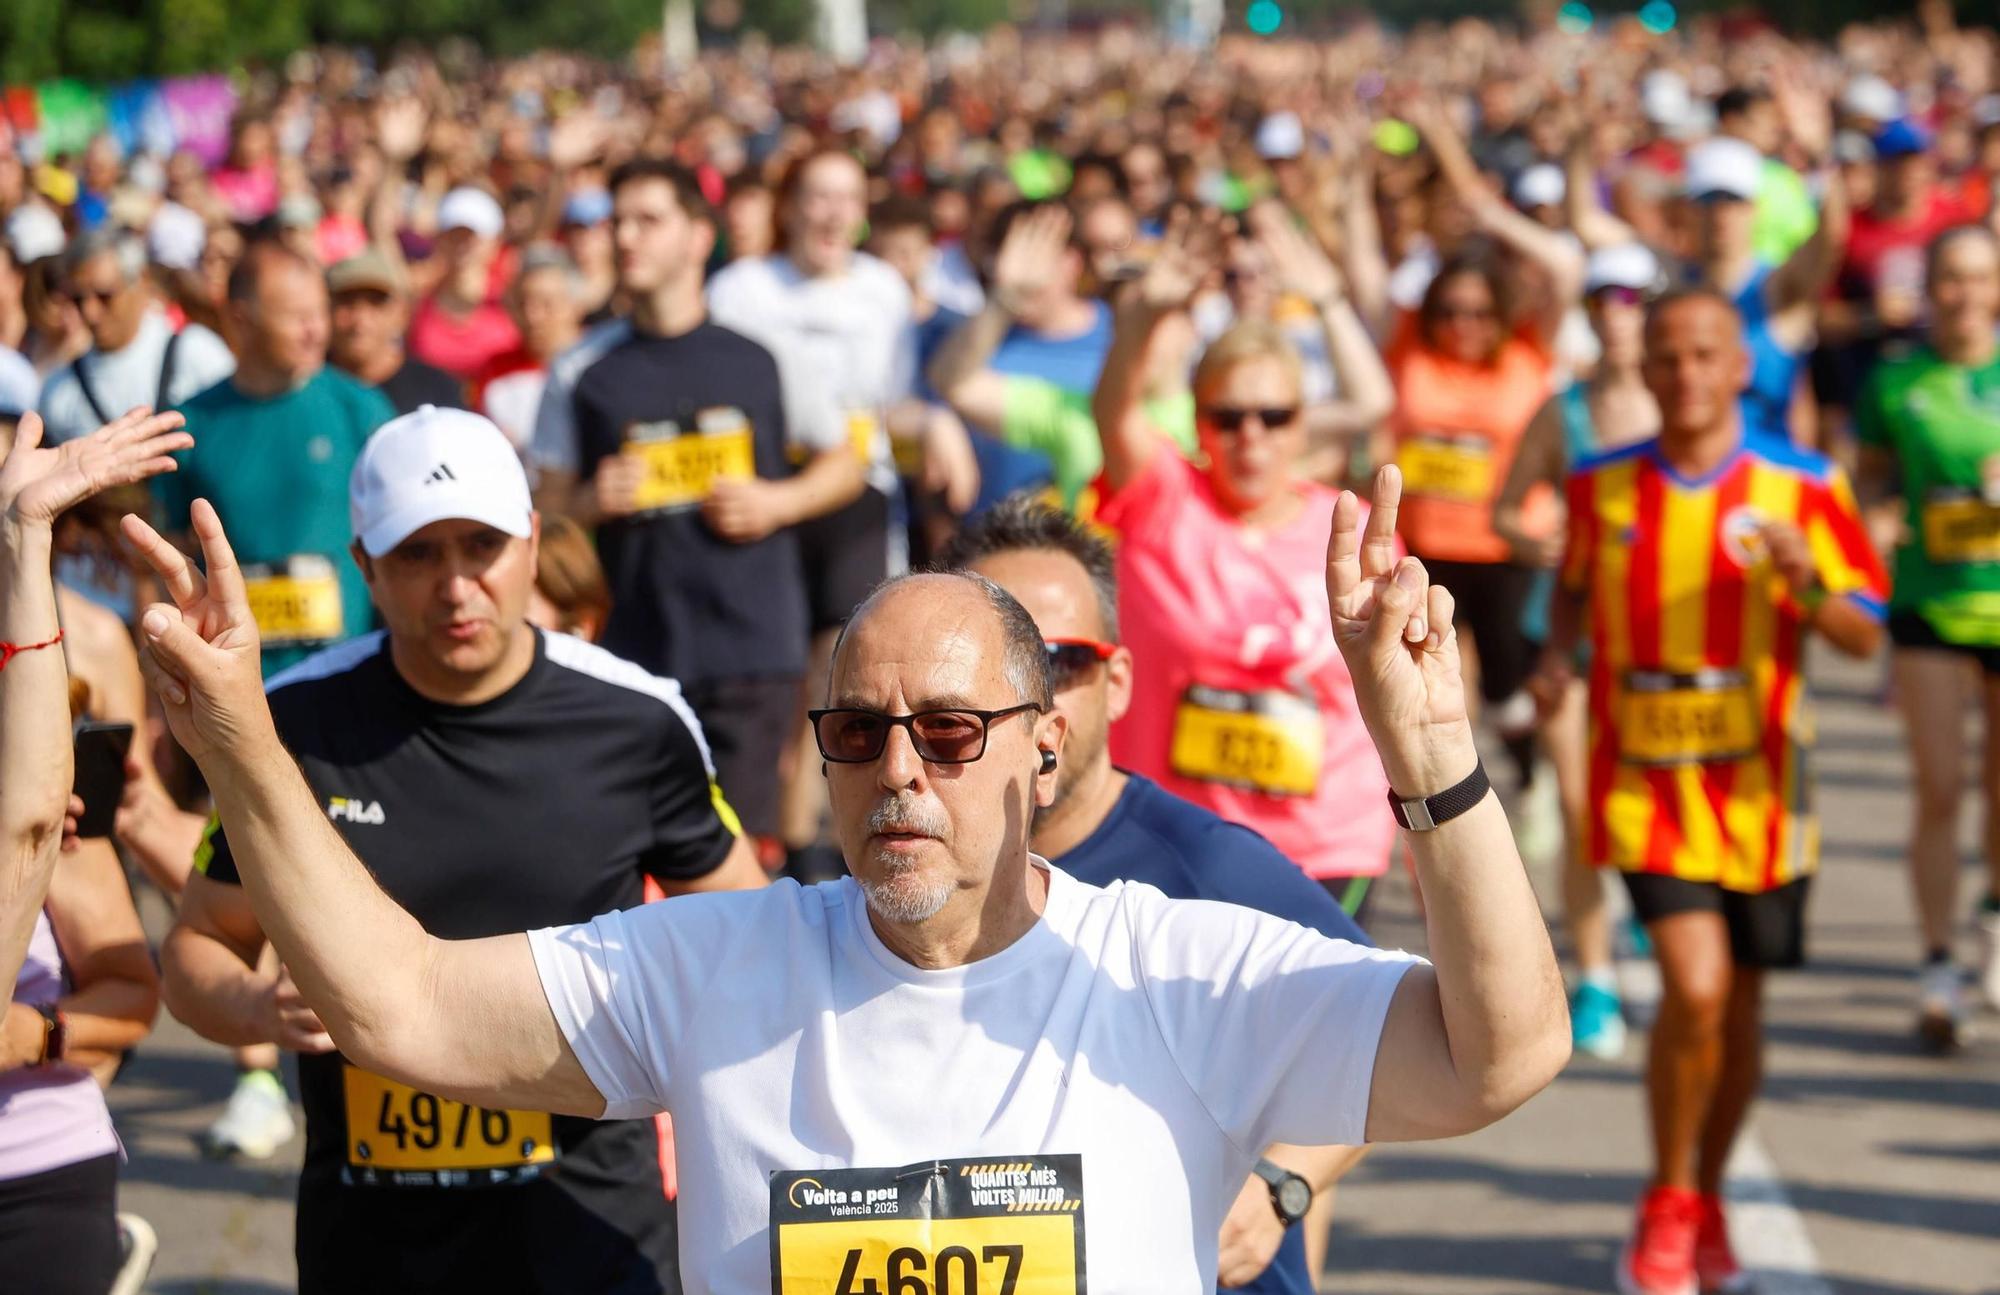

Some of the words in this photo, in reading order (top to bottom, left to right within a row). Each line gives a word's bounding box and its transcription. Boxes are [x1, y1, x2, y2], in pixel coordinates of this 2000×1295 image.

[328, 796, 385, 825] FILA
[378, 1090, 511, 1150] 4976
[970, 1170, 1028, 1189] QUANTES
[1030, 1165, 1057, 1187] MÉS
[803, 1188, 847, 1205] Volta
[851, 1190, 863, 1203] a
[866, 1188, 898, 1205] peu
[830, 1204, 872, 1216] València
[874, 1201, 899, 1214] 2025
[971, 1189, 1016, 1206] VOLTES
[1018, 1187, 1065, 1205] MILLOR
[834, 1244, 1024, 1295] 4607
